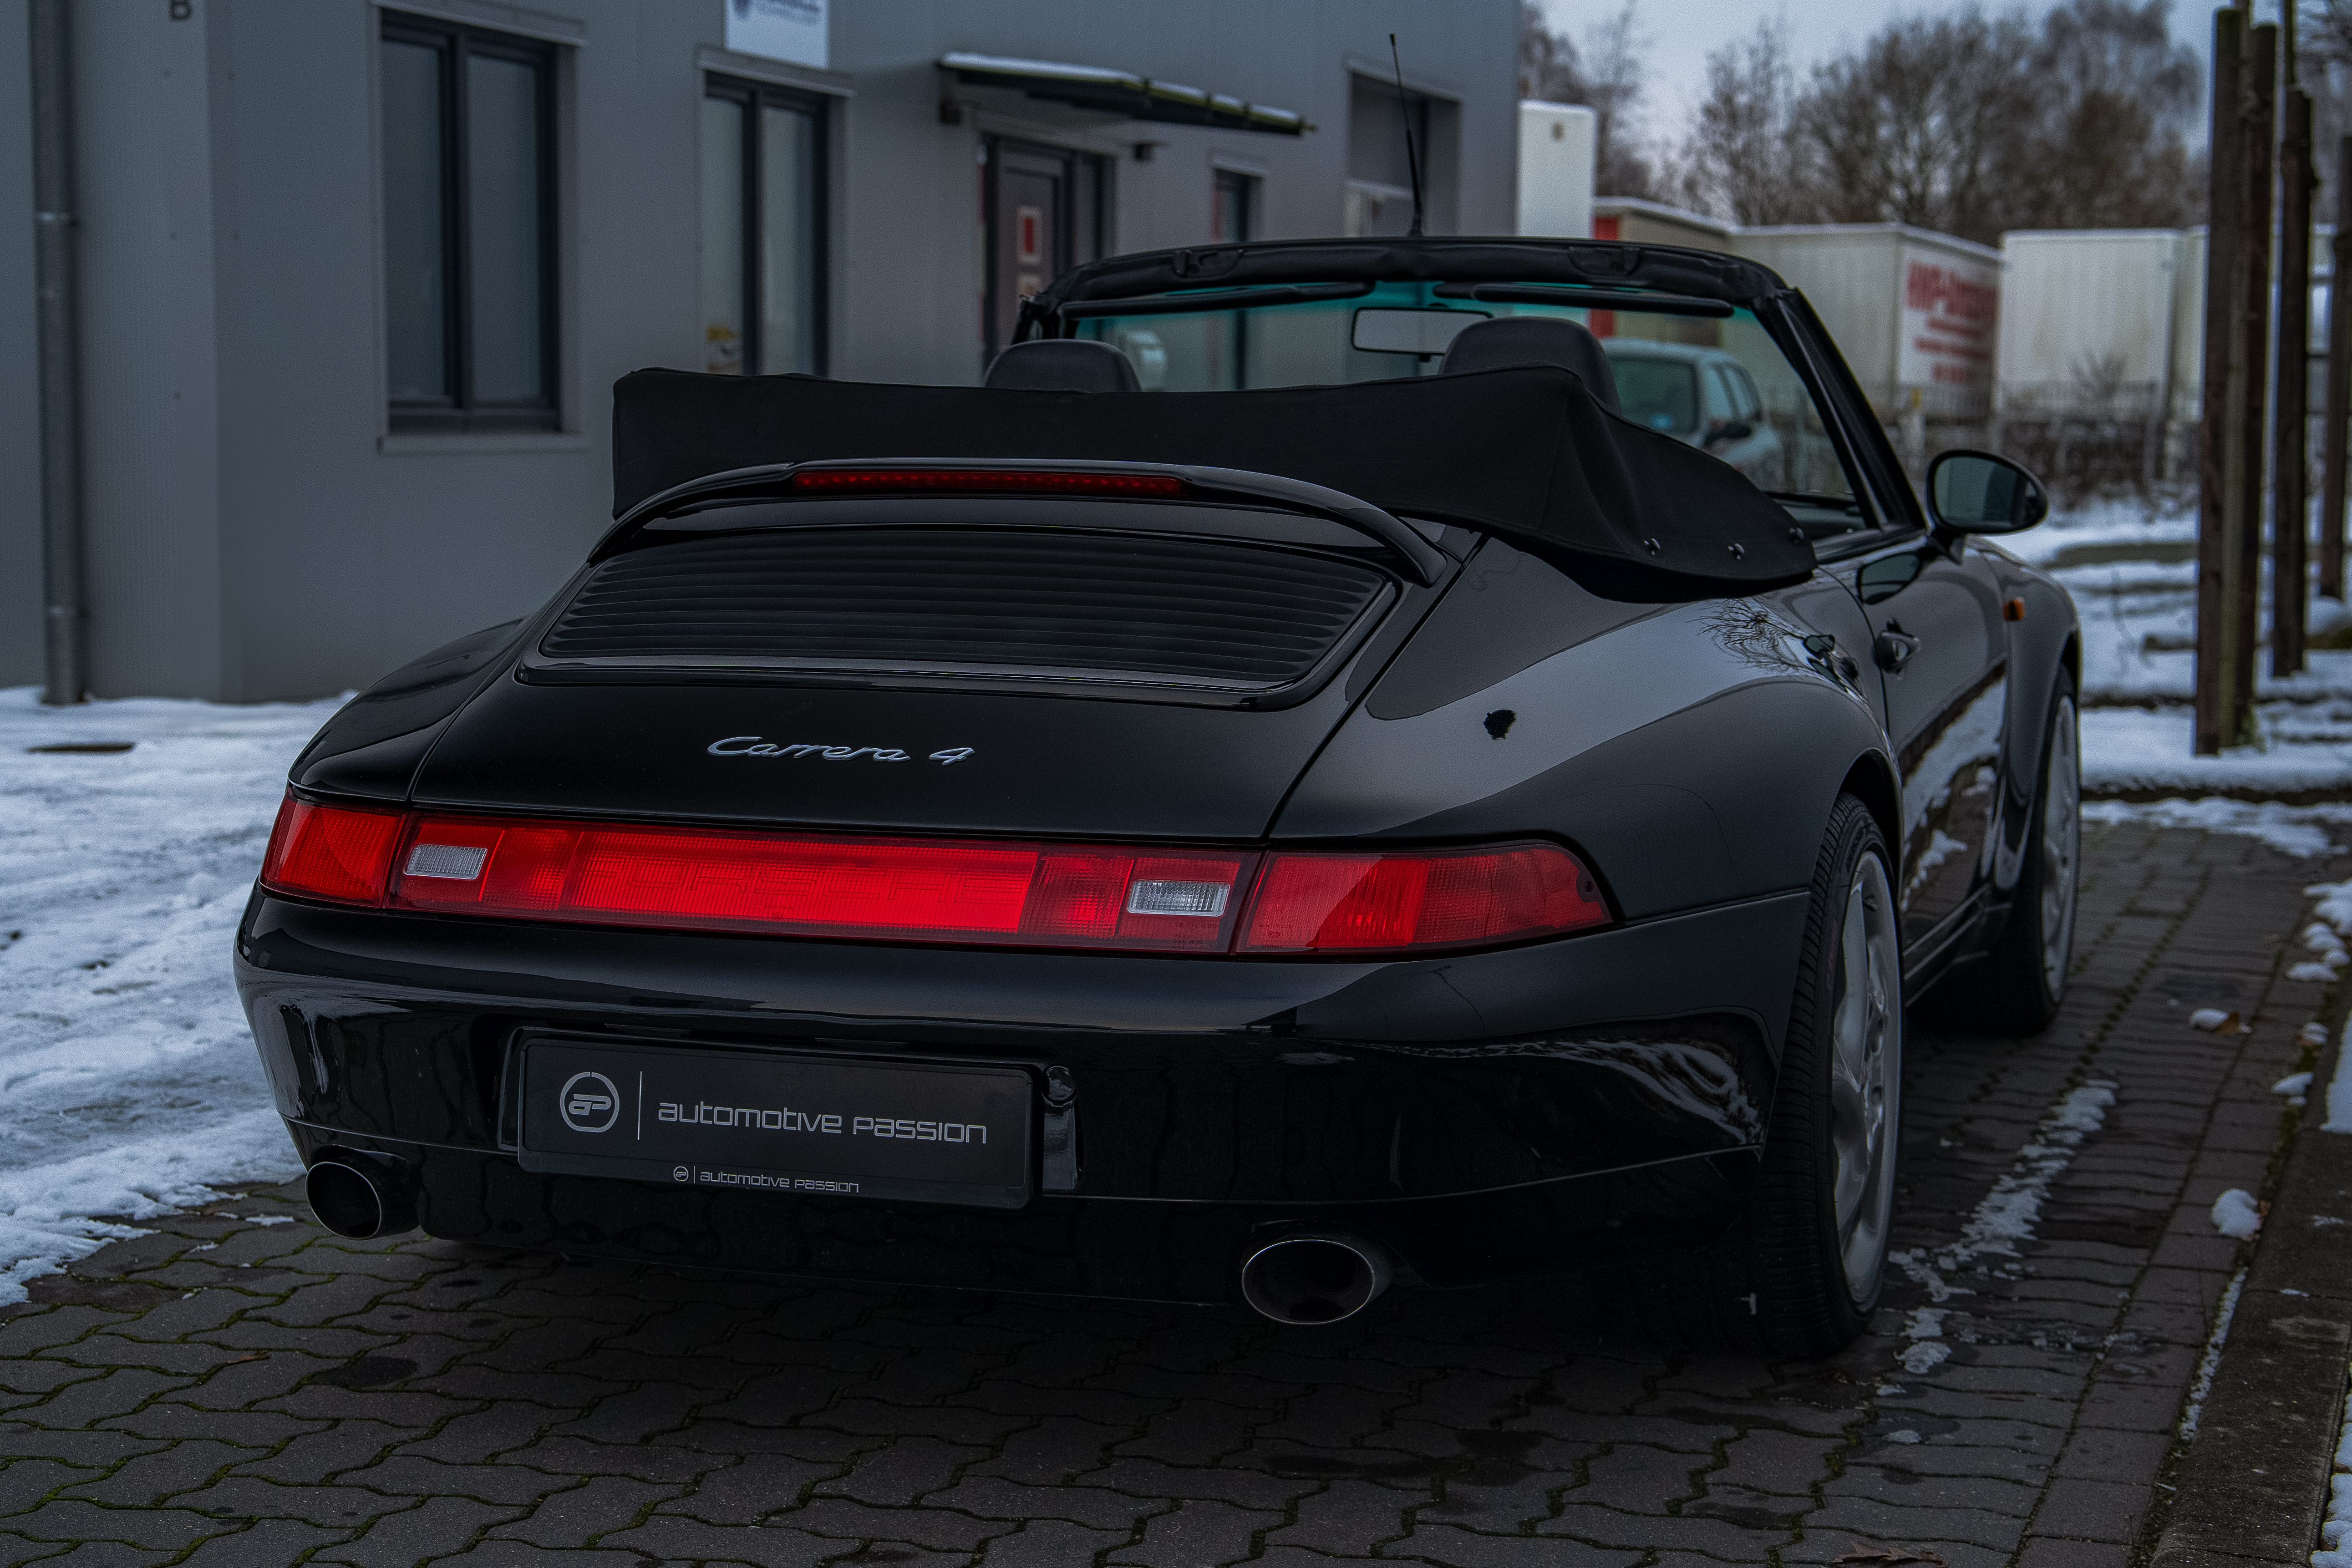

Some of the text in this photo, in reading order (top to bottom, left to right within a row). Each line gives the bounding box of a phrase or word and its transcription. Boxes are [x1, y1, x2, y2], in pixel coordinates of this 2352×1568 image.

[707, 736, 975, 766] Carrera 4
[659, 1101, 842, 1134] automotive
[701, 1171, 790, 1188] automotive
